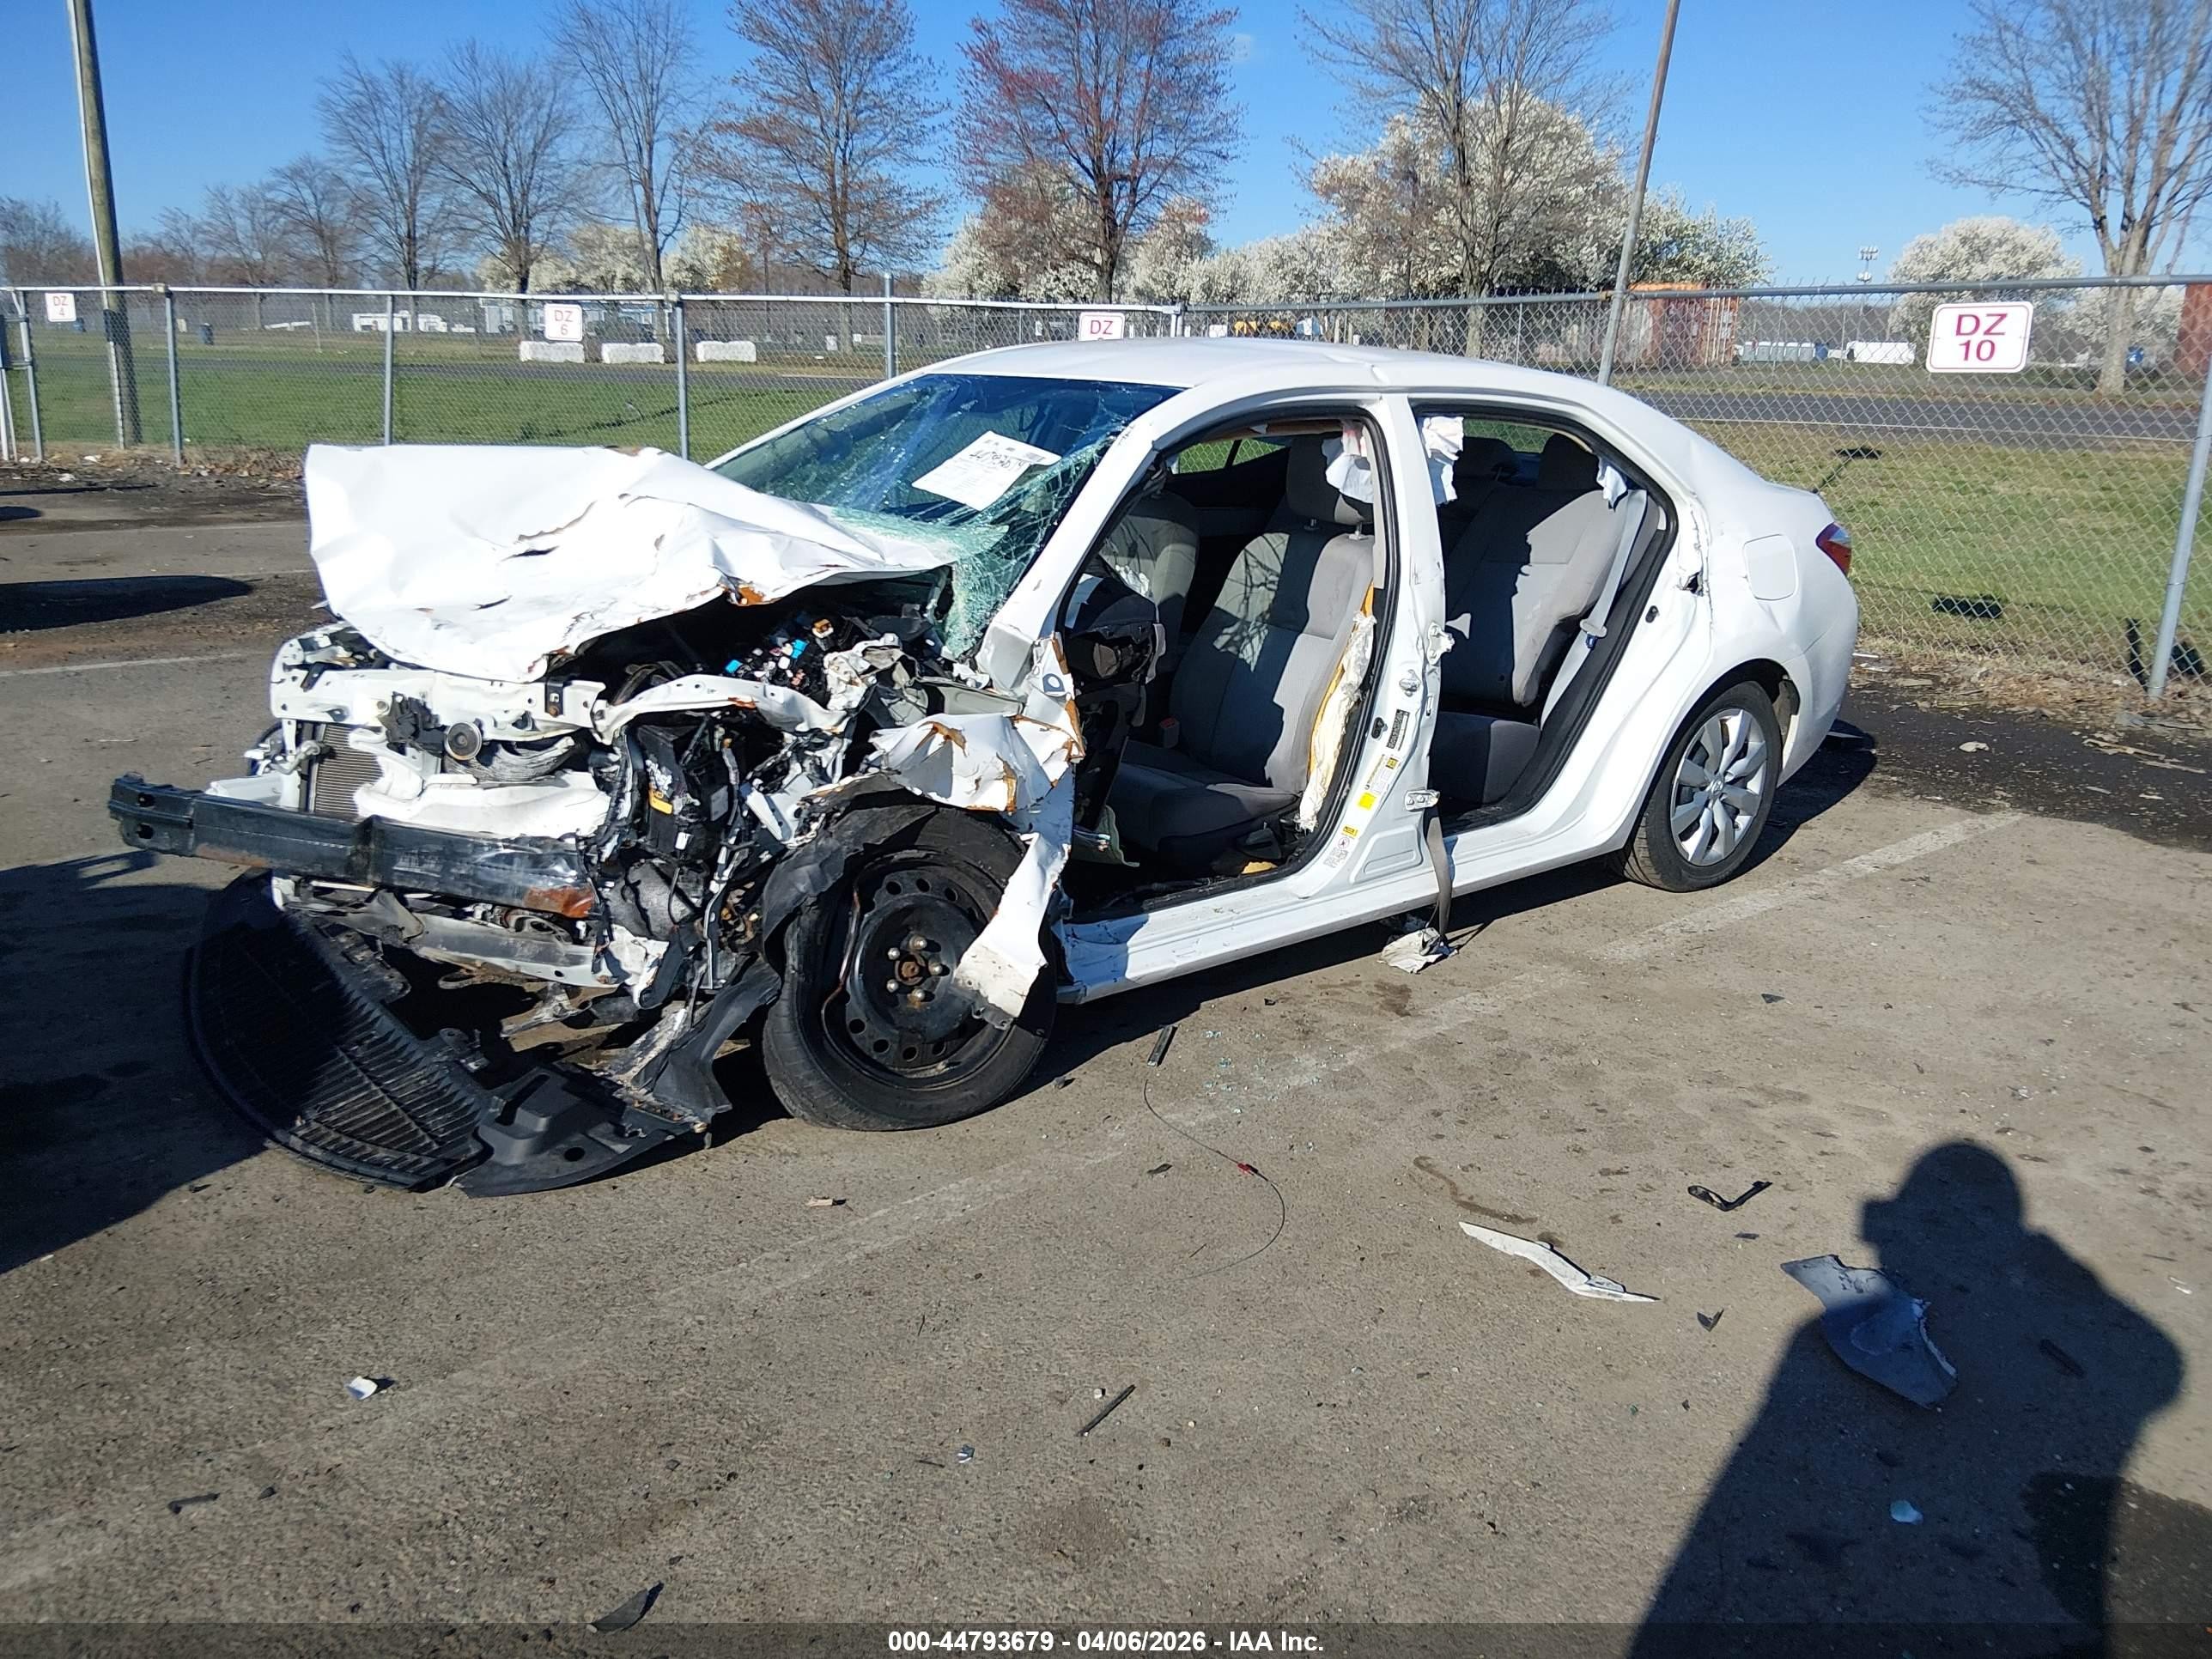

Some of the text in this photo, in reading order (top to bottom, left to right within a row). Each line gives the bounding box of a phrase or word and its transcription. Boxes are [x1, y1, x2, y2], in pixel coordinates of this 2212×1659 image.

[52, 295, 69, 307] DZ
[554, 309, 574, 323] DZ
[560, 324, 568, 336] 6
[1090, 319, 1114, 335] DZ
[1955, 313, 2008, 337] DZ
[1959, 339, 1996, 362] 10
